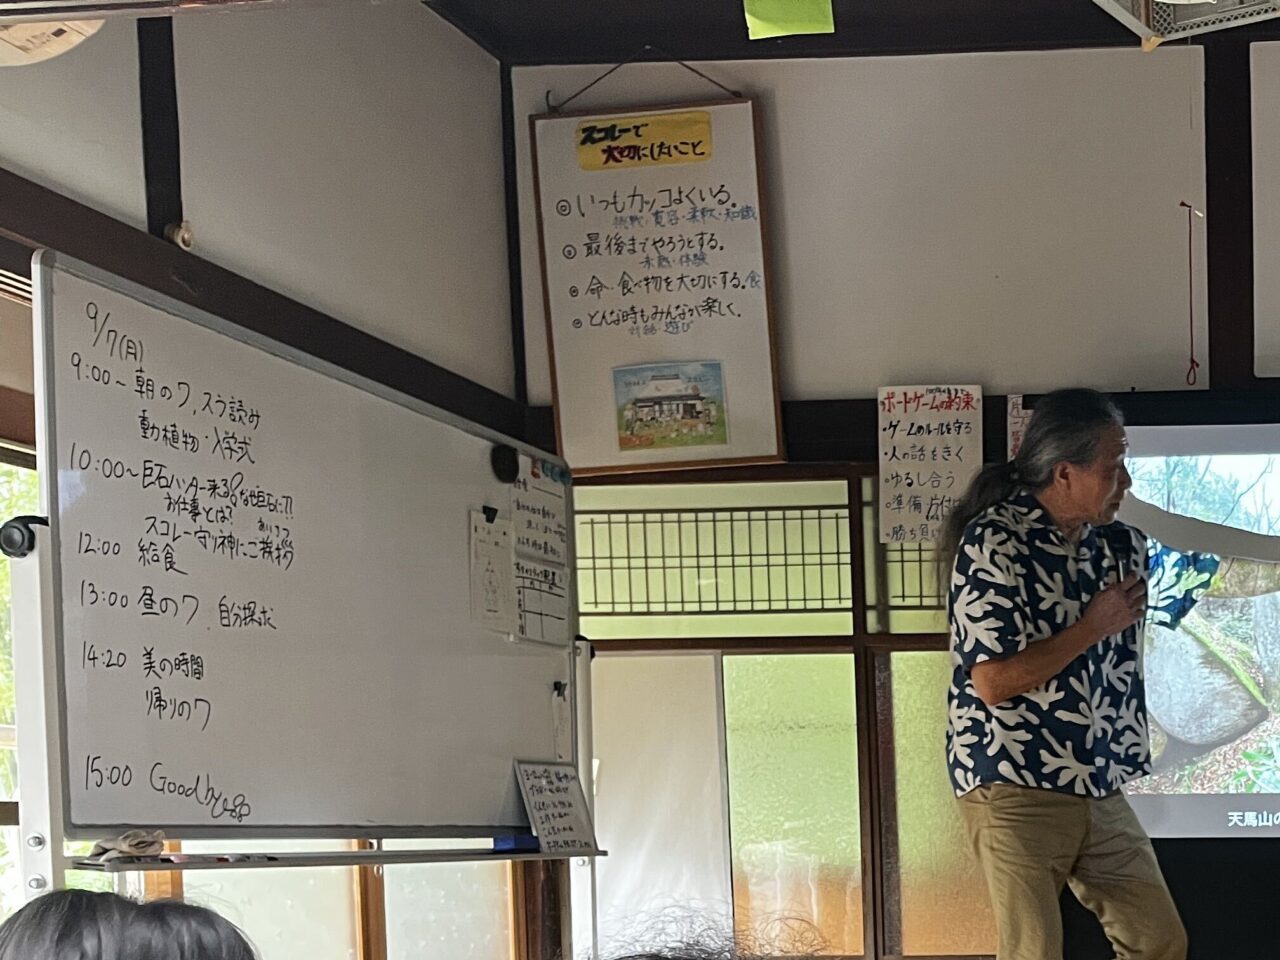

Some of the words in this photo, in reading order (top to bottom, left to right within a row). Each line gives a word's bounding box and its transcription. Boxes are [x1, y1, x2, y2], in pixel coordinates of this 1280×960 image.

[580, 123, 648, 145] スコレーで
[601, 140, 705, 165] 大切にしたいこと
[78, 532, 120, 555] 12:00
[138, 538, 188, 575] 給食
[80, 580, 128, 608] 13:00
[83, 641, 127, 669] 14:20
[142, 646, 204, 680] 美の時間
[85, 755, 132, 790] 15:00
